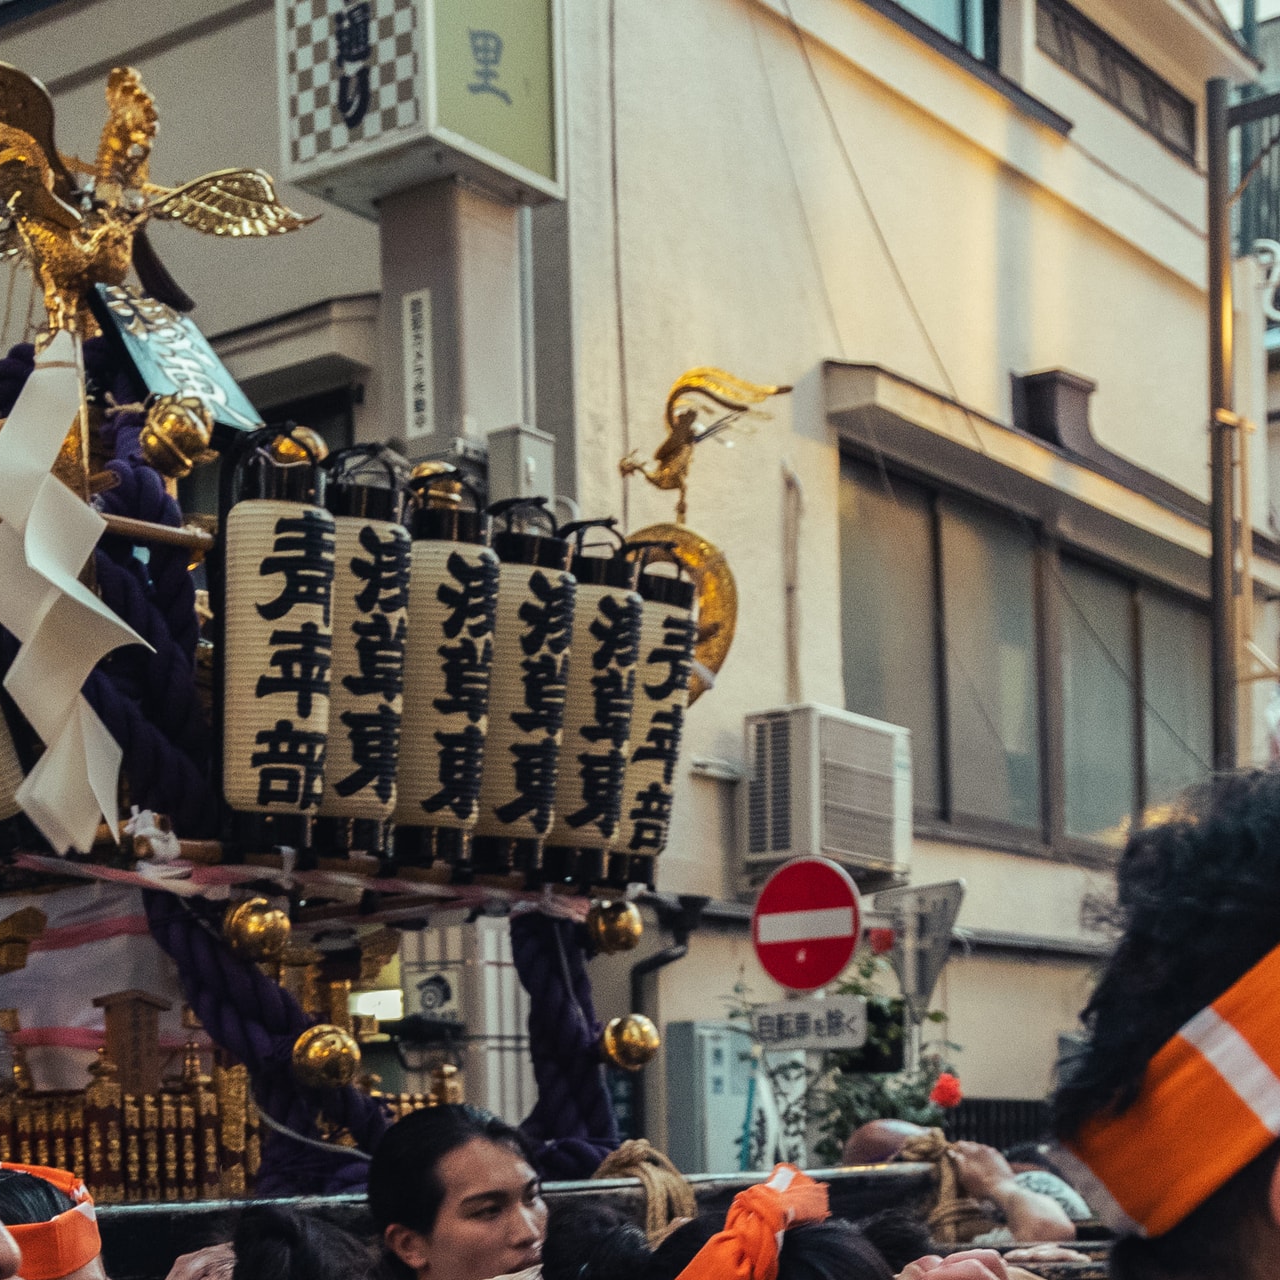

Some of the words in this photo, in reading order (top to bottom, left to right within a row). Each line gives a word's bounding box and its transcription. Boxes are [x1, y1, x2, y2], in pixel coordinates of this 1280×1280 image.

[757, 1009, 858, 1042] 自転車を除く
